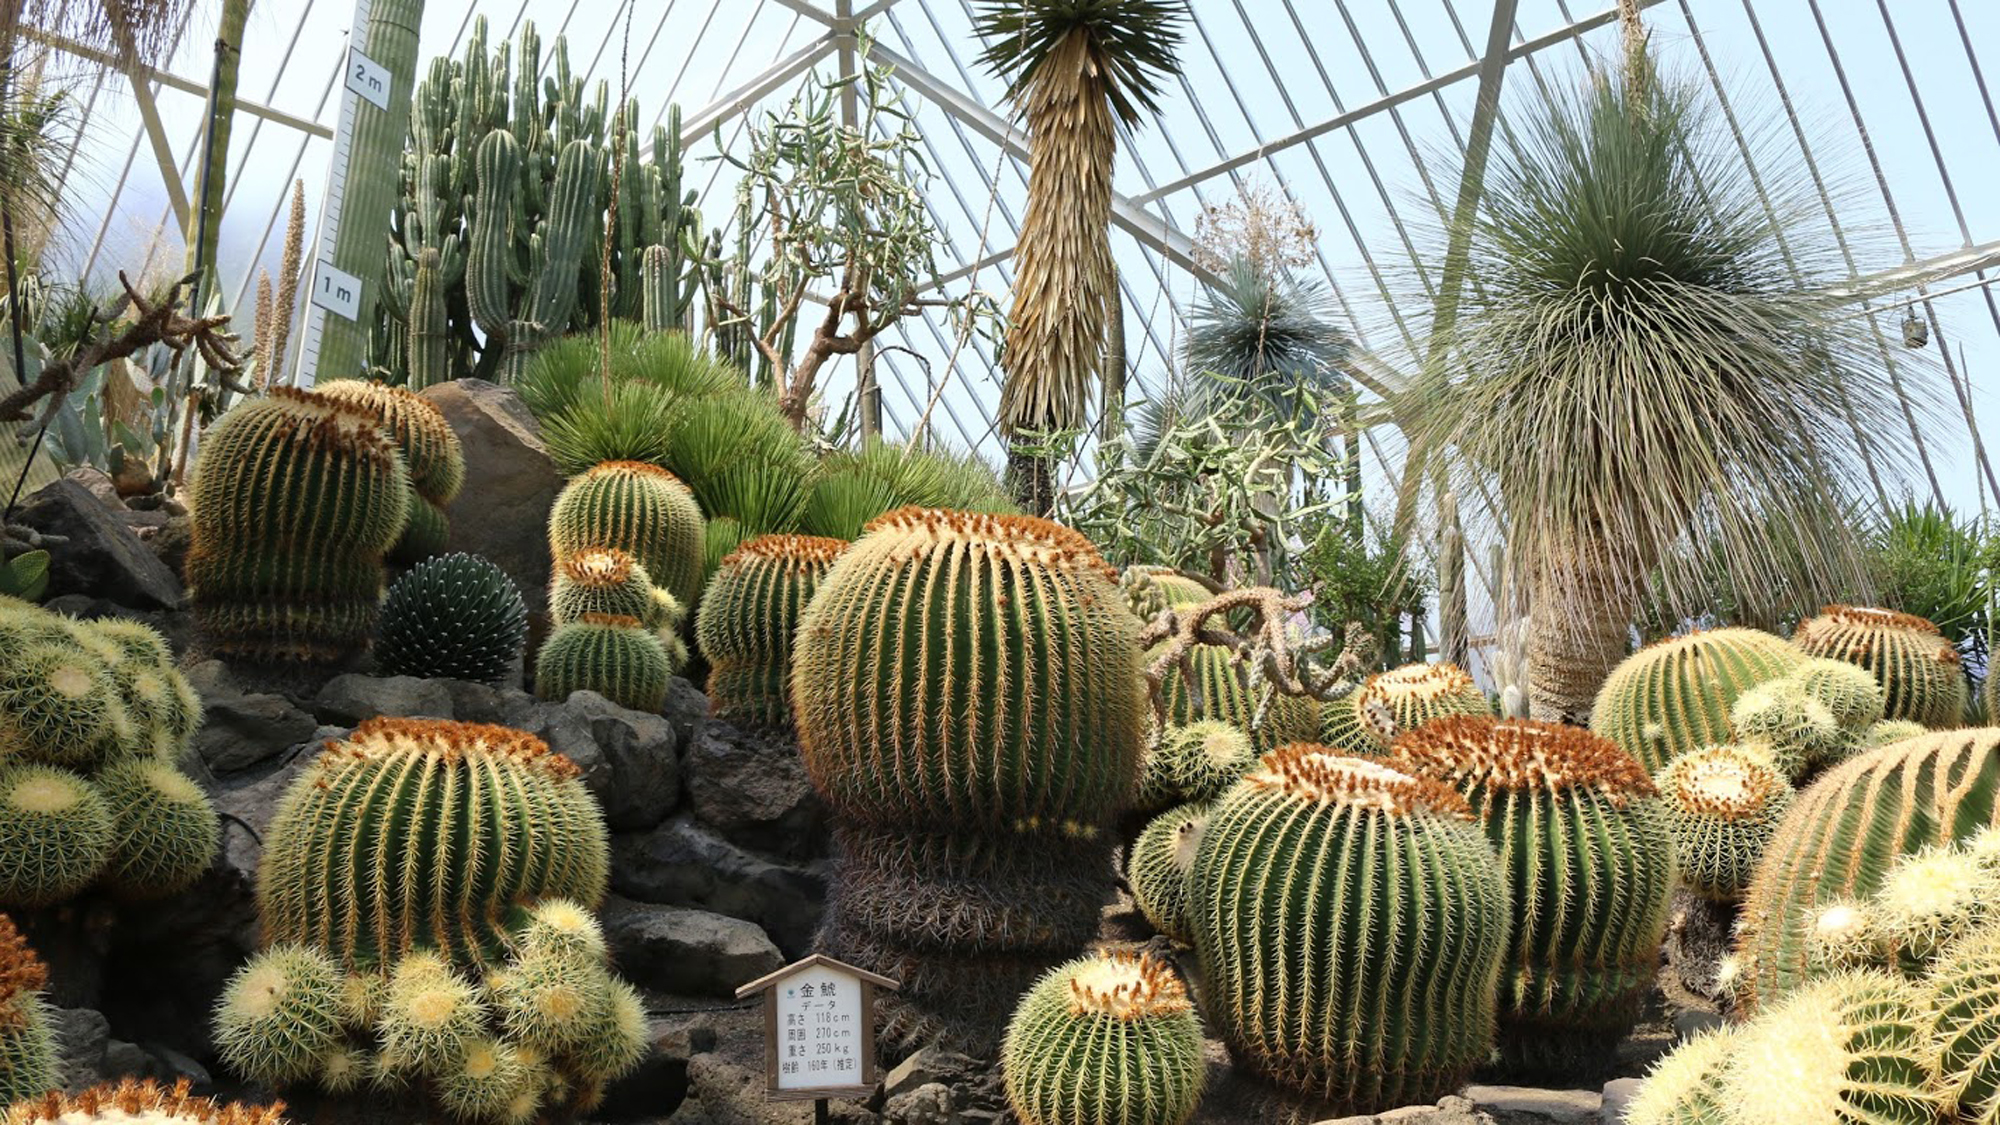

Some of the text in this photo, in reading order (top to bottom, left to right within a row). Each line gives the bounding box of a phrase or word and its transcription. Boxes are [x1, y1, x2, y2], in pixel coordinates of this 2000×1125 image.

[355, 64, 382, 93] 2 m
[324, 276, 351, 304] 1 m
[801, 1000, 837, 1012] データ
[787, 1013, 805, 1026] 高さ
[787, 1028, 806, 1042] 周囲
[788, 1044, 806, 1058] 重さ
